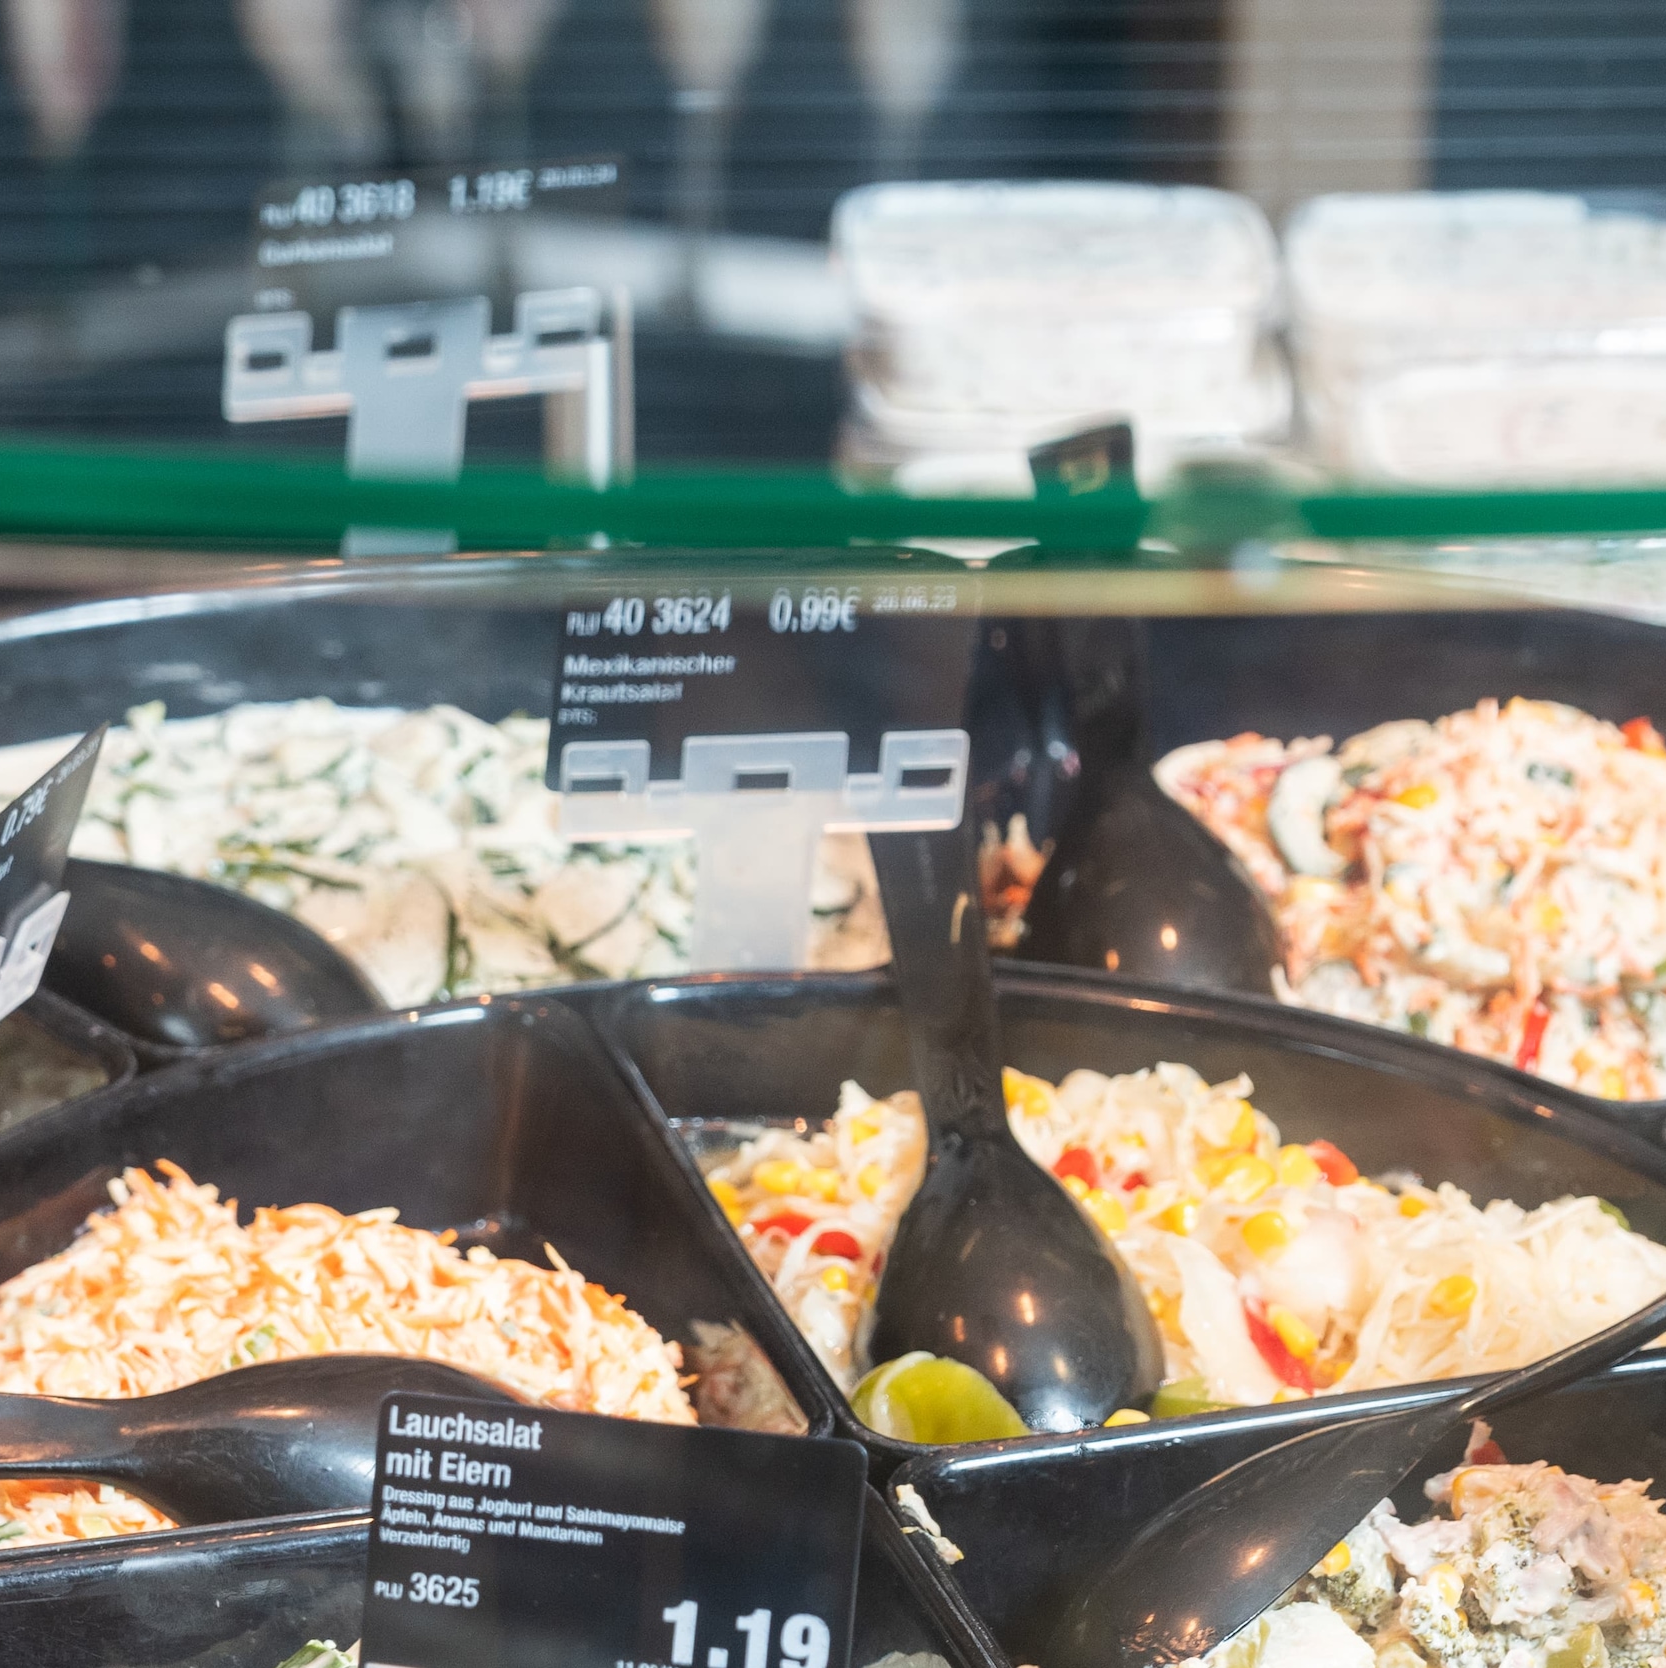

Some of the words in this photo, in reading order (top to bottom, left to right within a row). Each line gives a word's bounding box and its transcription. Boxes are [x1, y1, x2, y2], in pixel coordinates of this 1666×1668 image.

[566, 611, 601, 636] PLU
[603, 596, 645, 636] 40
[652, 591, 732, 635] 3624
[564, 653, 737, 678] Mexikanischer
[561, 681, 684, 704] Krautsalat
[388, 1405, 543, 1451] Lauchsalat
[385, 1449, 432, 1479] mit
[439, 1452, 512, 1488] Eiern
[380, 1504, 430, 1529] Äpfeln,
[433, 1511, 485, 1534] Ananas
[489, 1516, 516, 1536] und
[518, 1521, 603, 1545] Mandarinen
[381, 1485, 446, 1510] Dressing
[448, 1494, 475, 1511] aus
[477, 1496, 533, 1521] Joghurt
[536, 1502, 564, 1520] und
[566, 1504, 686, 1535] Salatmayonnaise
[379, 1526, 471, 1553] Verzehrfertig
[374, 1580, 404, 1600] PLU
[409, 1572, 480, 1608] 3625
